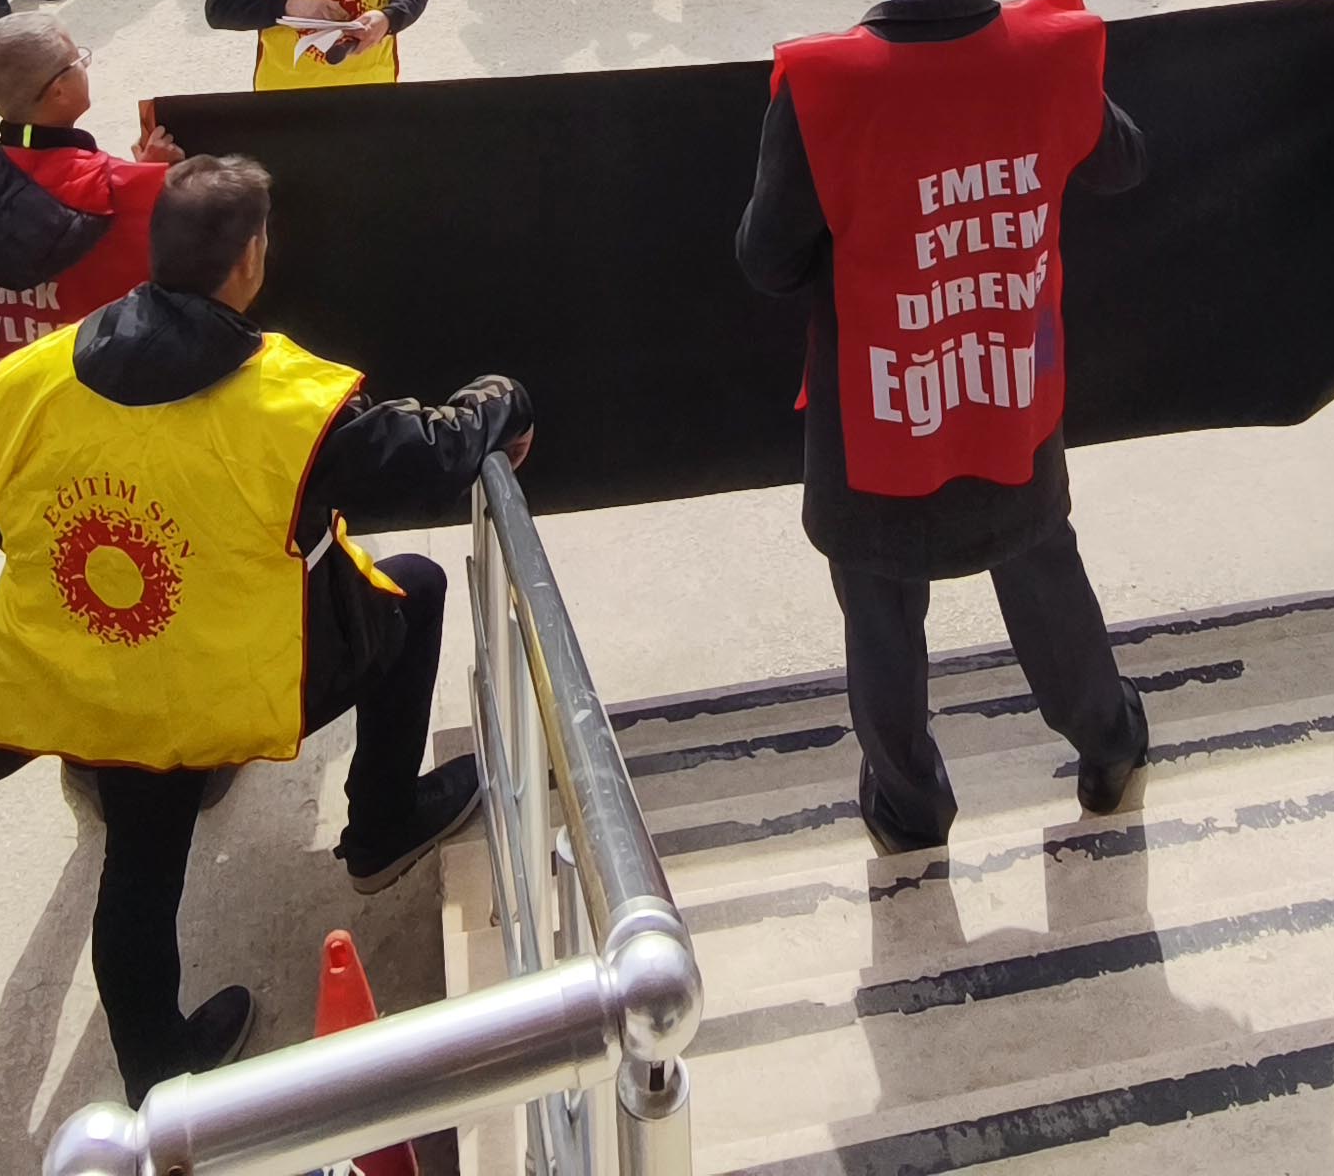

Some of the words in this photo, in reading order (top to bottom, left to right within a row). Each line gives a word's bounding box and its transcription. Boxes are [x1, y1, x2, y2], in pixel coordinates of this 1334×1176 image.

[918, 153, 1042, 216] EMEK
[915, 202, 1049, 270] EYLEM
[42, 471, 137, 529] EĞİTİM
[145, 500, 196, 559] SEN
